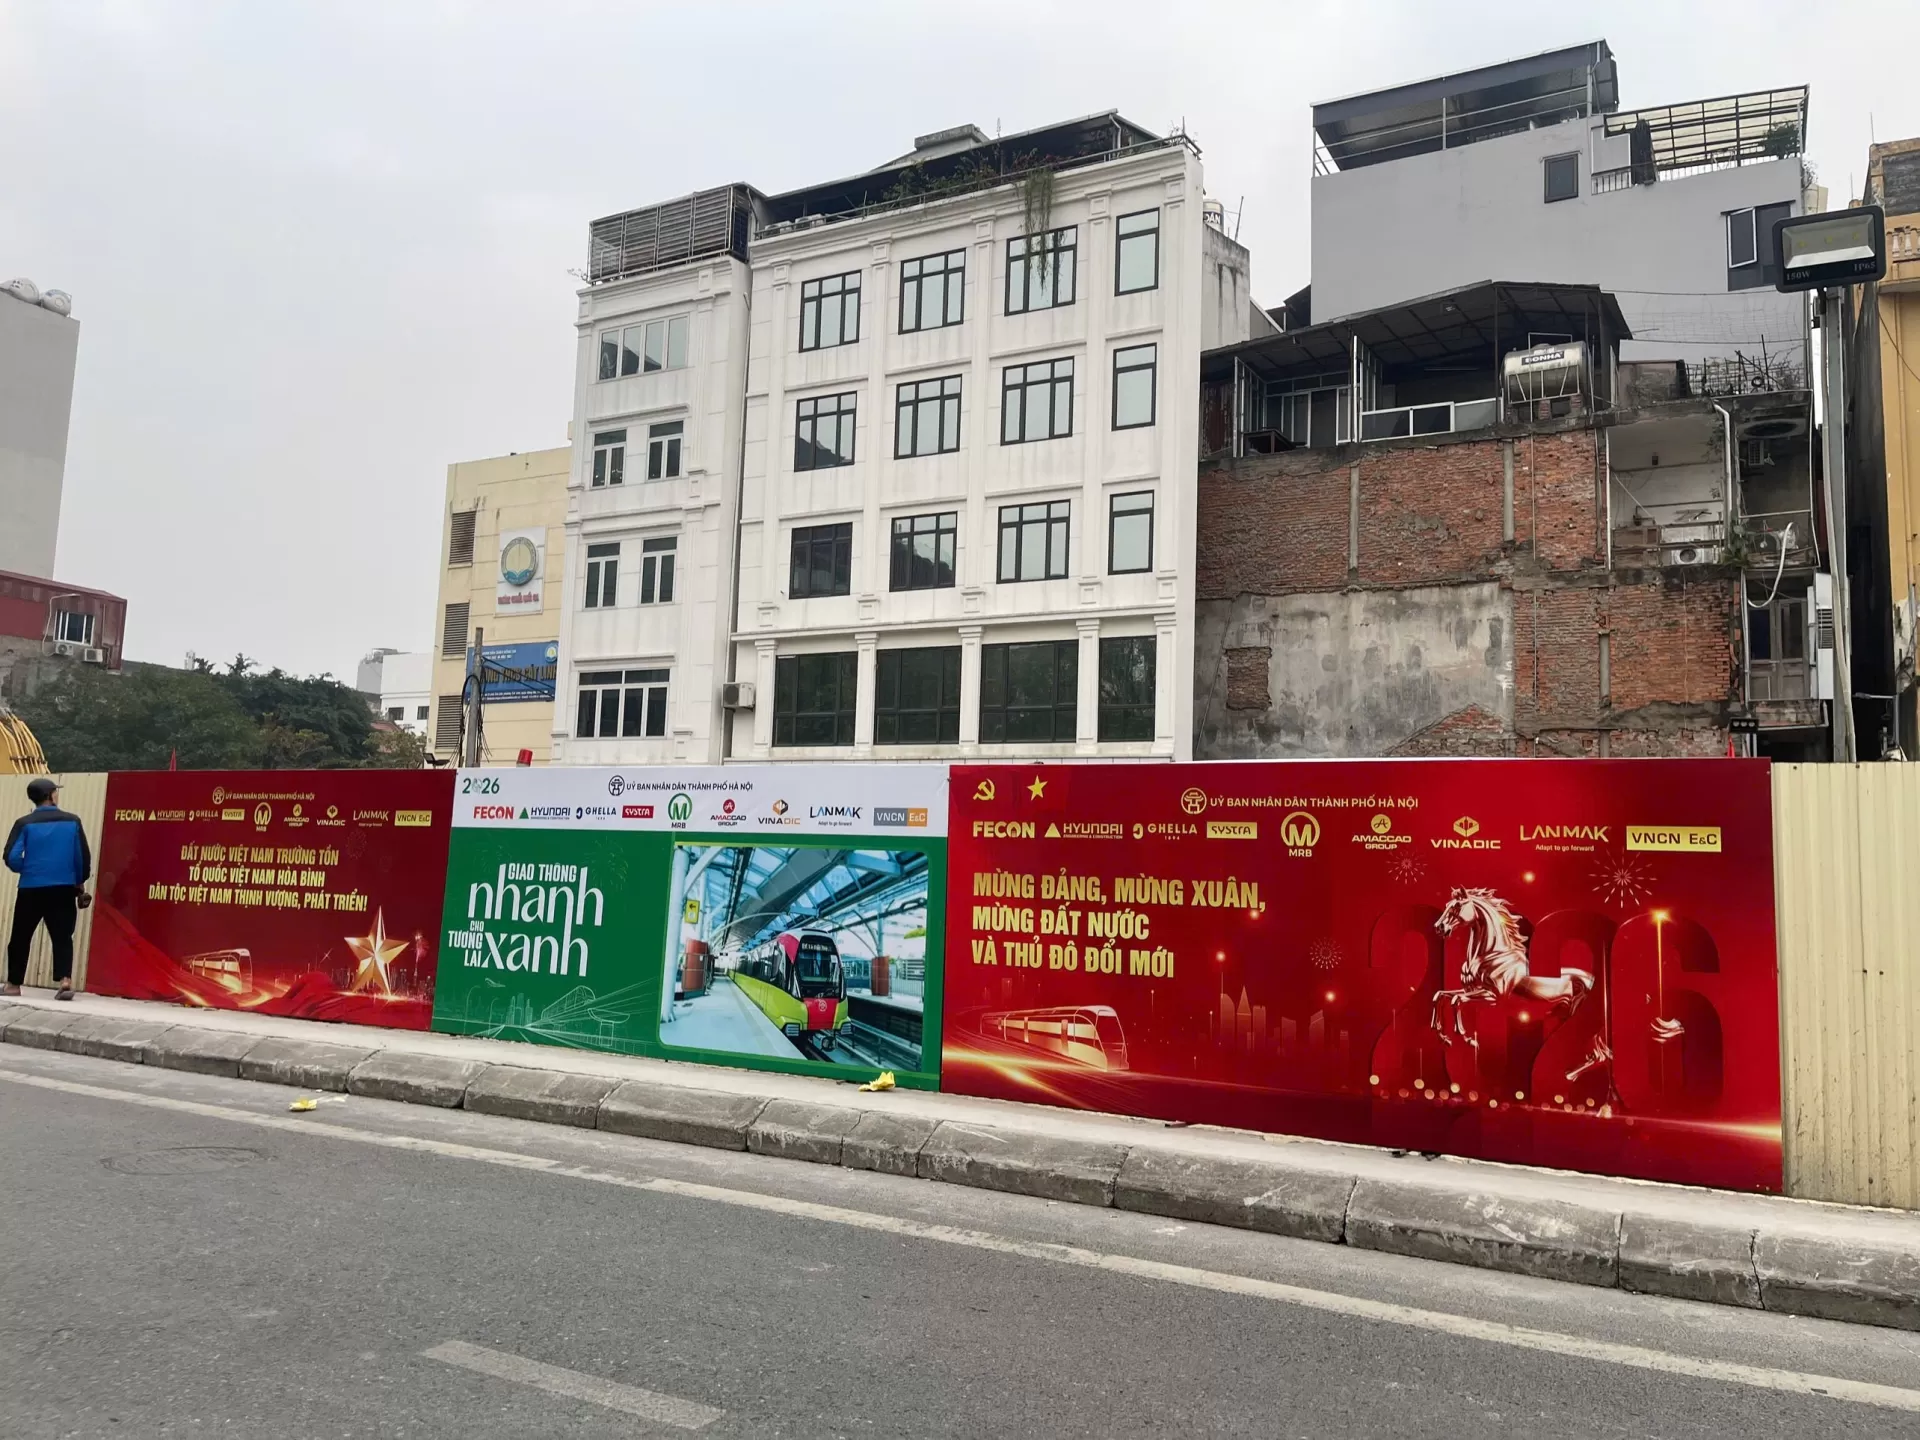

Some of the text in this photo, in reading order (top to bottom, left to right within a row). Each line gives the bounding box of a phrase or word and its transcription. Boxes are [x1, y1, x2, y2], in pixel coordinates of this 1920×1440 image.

[1854, 262, 1876, 272] IP65
[1786, 271, 1810, 280] 150W
[652, 782, 670, 790] NHÂN
[672, 782, 686, 790] DÂN
[688, 782, 711, 790] THÀNH
[712, 780, 728, 790] PHỐ
[728, 782, 738, 790] HÀ
[740, 782, 753, 792] NỘI
[1210, 794, 1418, 810] UỶ BAN NHÂN DÂN THÀNH PHỐ HÀ NỘI
[115, 810, 145, 821] FECON
[353, 810, 390, 822] LANMAK
[473, 806, 514, 820] FECON
[531, 807, 571, 816] HYUNDAI
[586, 807, 616, 815] GHELLA
[810, 806, 861, 819] LANMAK
[876, 812, 926, 822] VNCN E&C
[398, 814, 416, 822] VNCN
[973, 821, 1035, 838] FECON
[1063, 822, 1123, 834] HYUNDAI
[1148, 823, 1198, 834] GHELLA
[1211, 826, 1251, 835] SYSTRA
[1520, 825, 1609, 842] LANMAK
[1352, 835, 1412, 843] AMACCAD
[1430, 839, 1500, 850] VINADIC
[1632, 832, 1718, 845] VNCN E&C
[180, 841, 340, 866] ĐẤT NƯỚC VIỆT NAM TRƯỜNG TỒN
[1289, 849, 1312, 858] MRB
[1536, 844, 1552, 852] Adapt
[189, 861, 326, 888] TỔ QUỐC VIỆT NAM HÒA BÌNH
[508, 862, 577, 882] GIAO THÔNG
[468, 863, 604, 926] nhanh
[973, 867, 1266, 913] MỪNG ĐẢNG, MỪNG XUÂN,
[148, 882, 368, 912] DÂN TỘC VIỆT NAM THỊNH VƯỢNG, PHÁT TRIỂN!
[470, 920, 484, 932] CHO
[972, 902, 1150, 940] MỪNG ĐẤT NƯỚC
[448, 930, 484, 950] TƯƠNG
[481, 919, 589, 977] xanh
[464, 949, 482, 967] LAI
[972, 935, 1174, 978] VÀ THỦ ĐÔ ĐỔI MỚI
